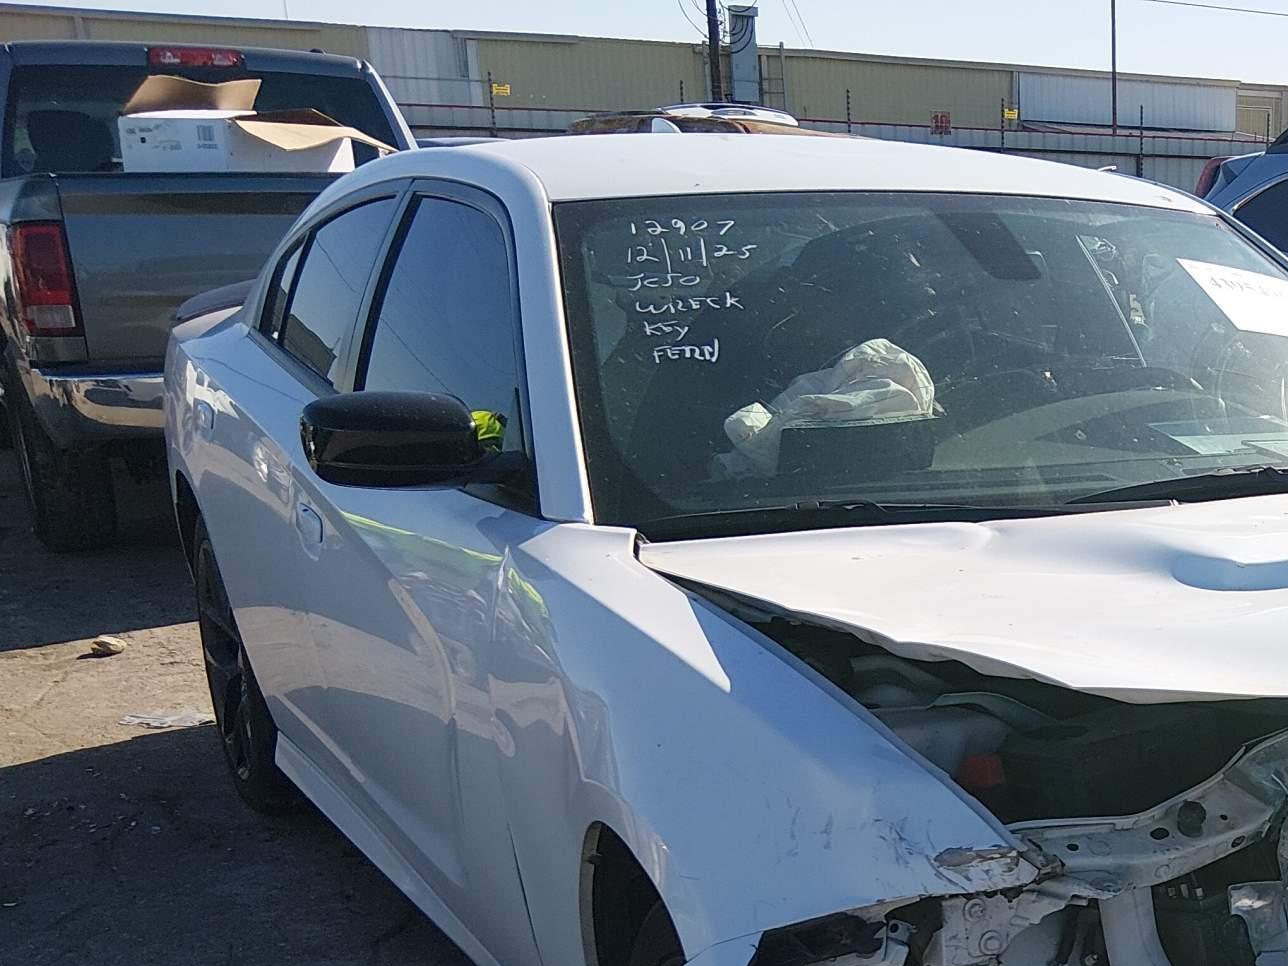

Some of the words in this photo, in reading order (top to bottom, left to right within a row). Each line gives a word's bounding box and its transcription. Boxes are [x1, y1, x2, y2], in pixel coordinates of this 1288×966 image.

[630, 218, 736, 236] 12907
[626, 237, 758, 274] 12/11/25
[635, 292, 745, 314] WRECK
